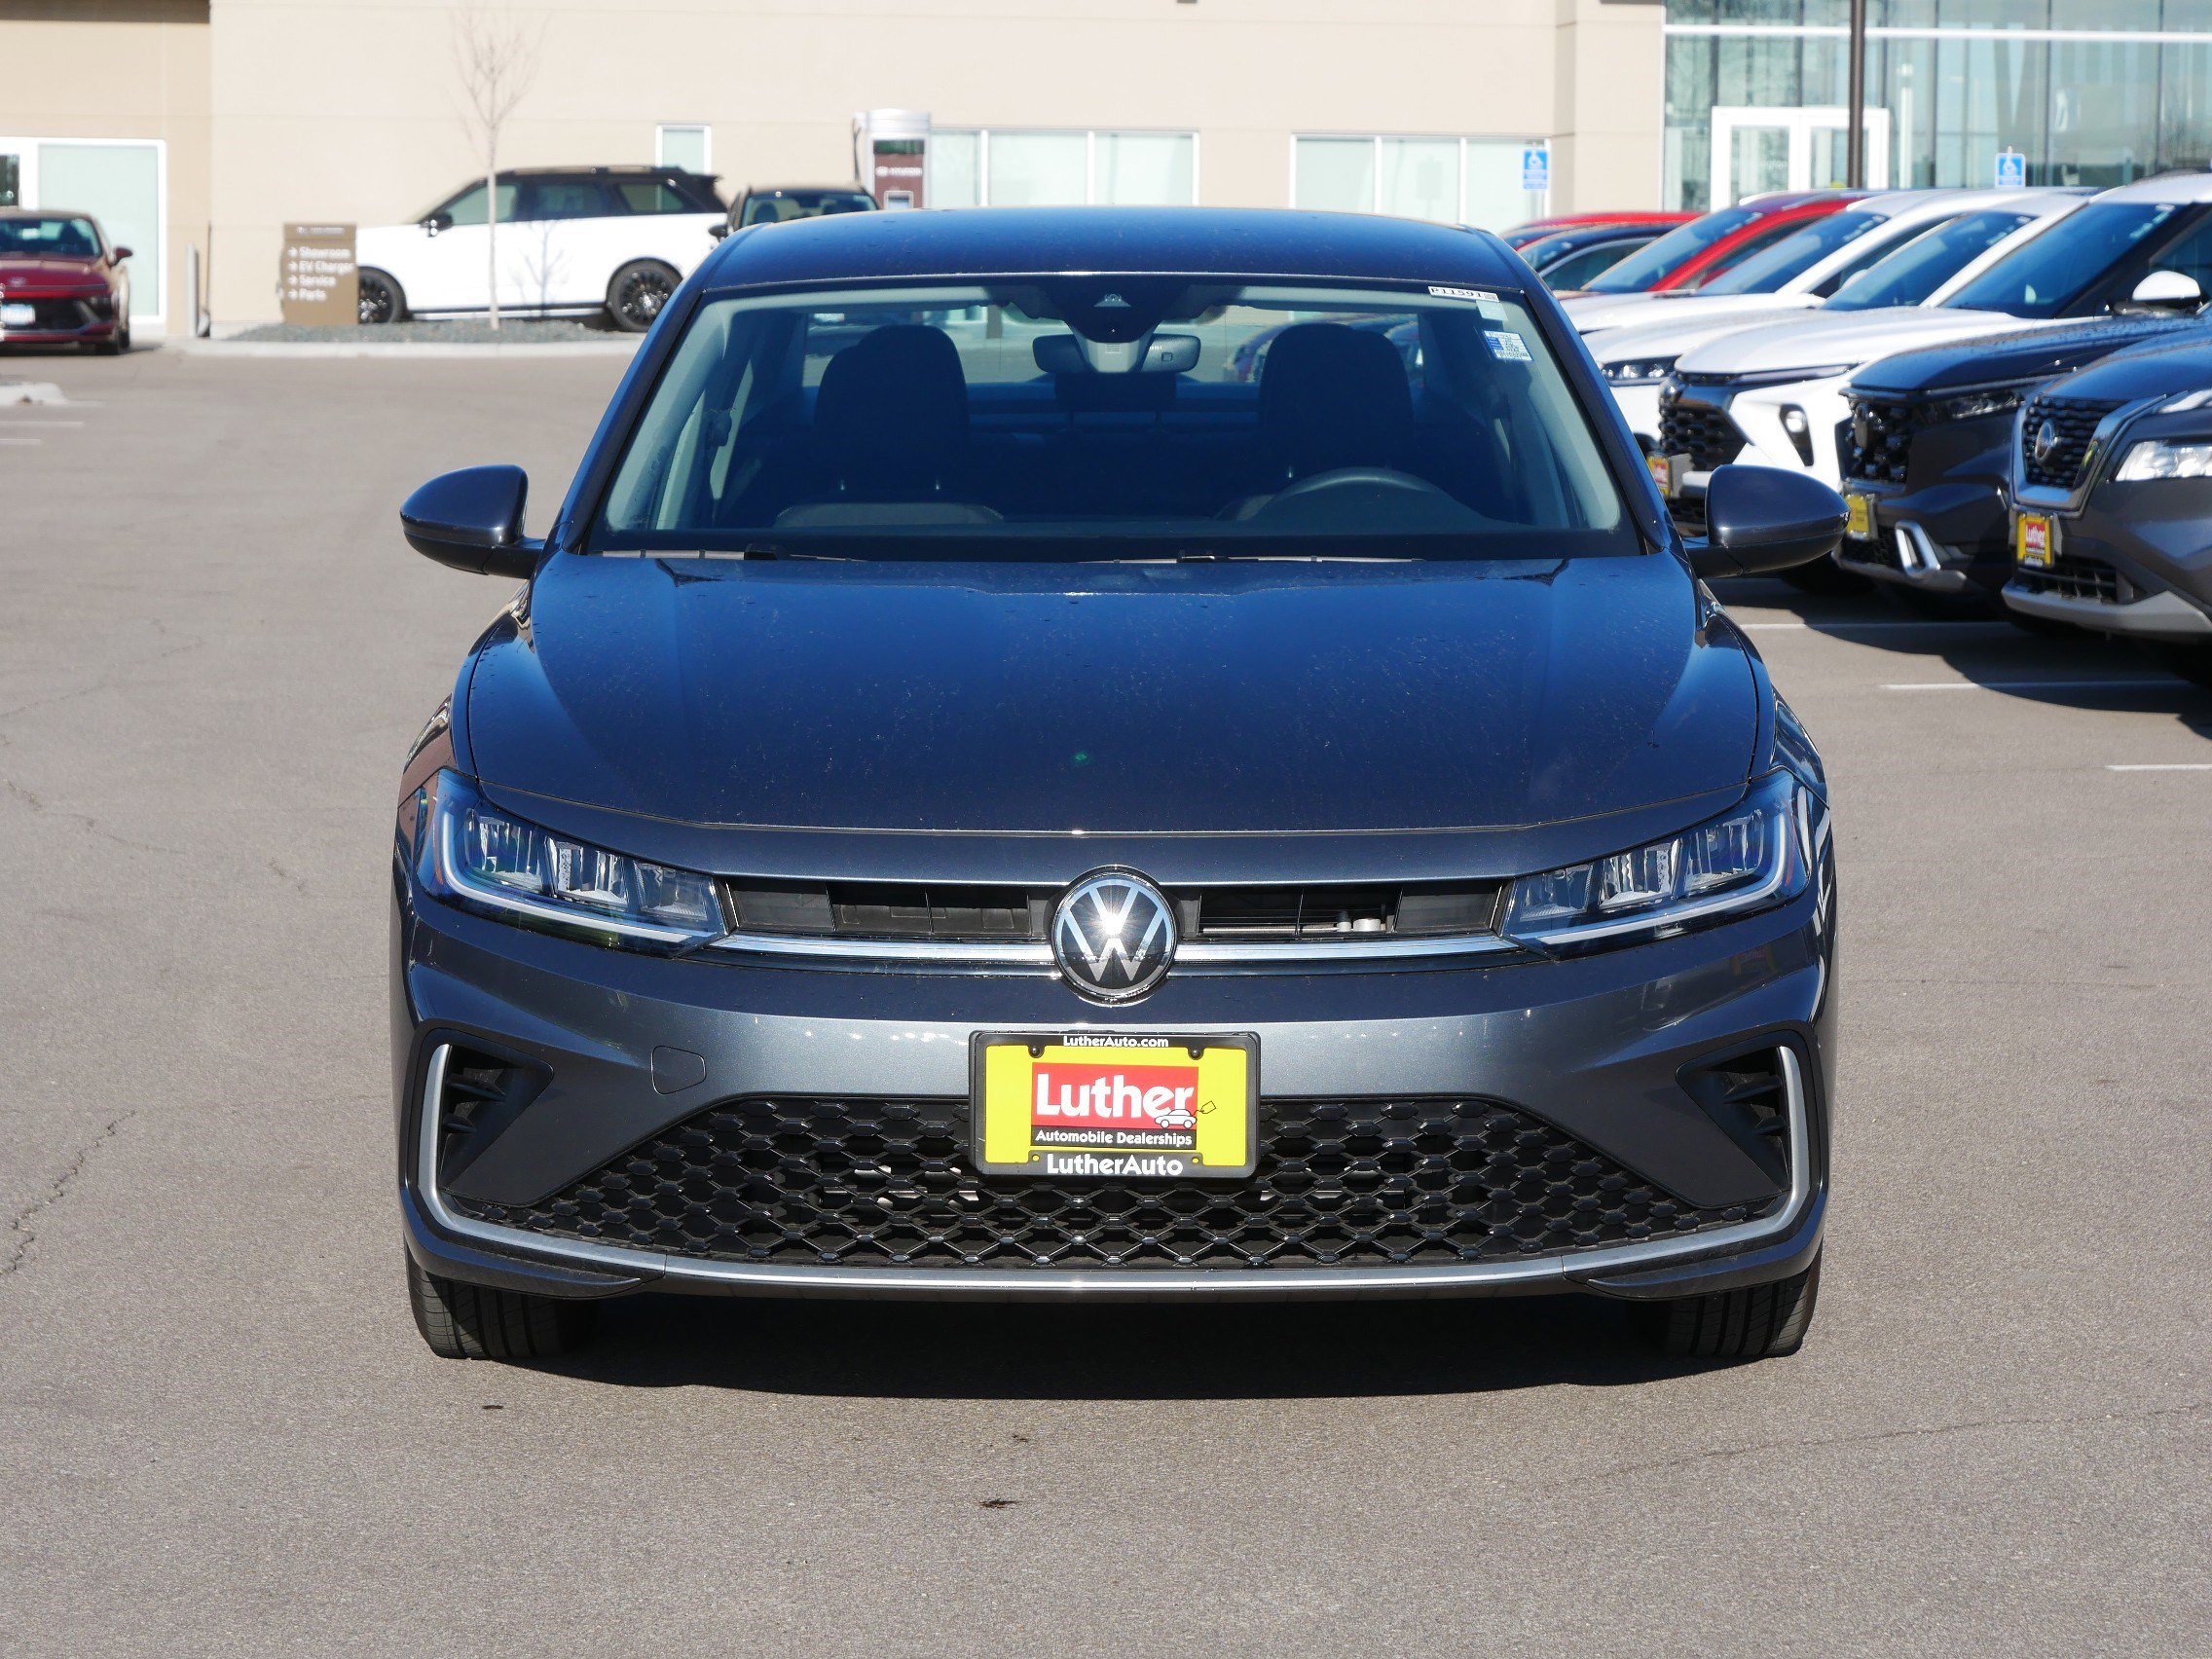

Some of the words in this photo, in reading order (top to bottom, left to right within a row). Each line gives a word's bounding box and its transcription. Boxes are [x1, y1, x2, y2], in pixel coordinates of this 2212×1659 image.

[298, 246, 350, 260] Showroom
[298, 260, 313, 274] EV
[314, 260, 354, 276] Charger
[298, 274, 337, 287] Service
[298, 288, 327, 301] Parts
[1063, 1035, 1169, 1048] LutherAuto.com
[1036, 1073, 1196, 1121] Luther
[1035, 1129, 1114, 1144] Automobile
[1117, 1131, 1193, 1147] Dealerships
[1047, 1153, 1184, 1176] LutherAuto
